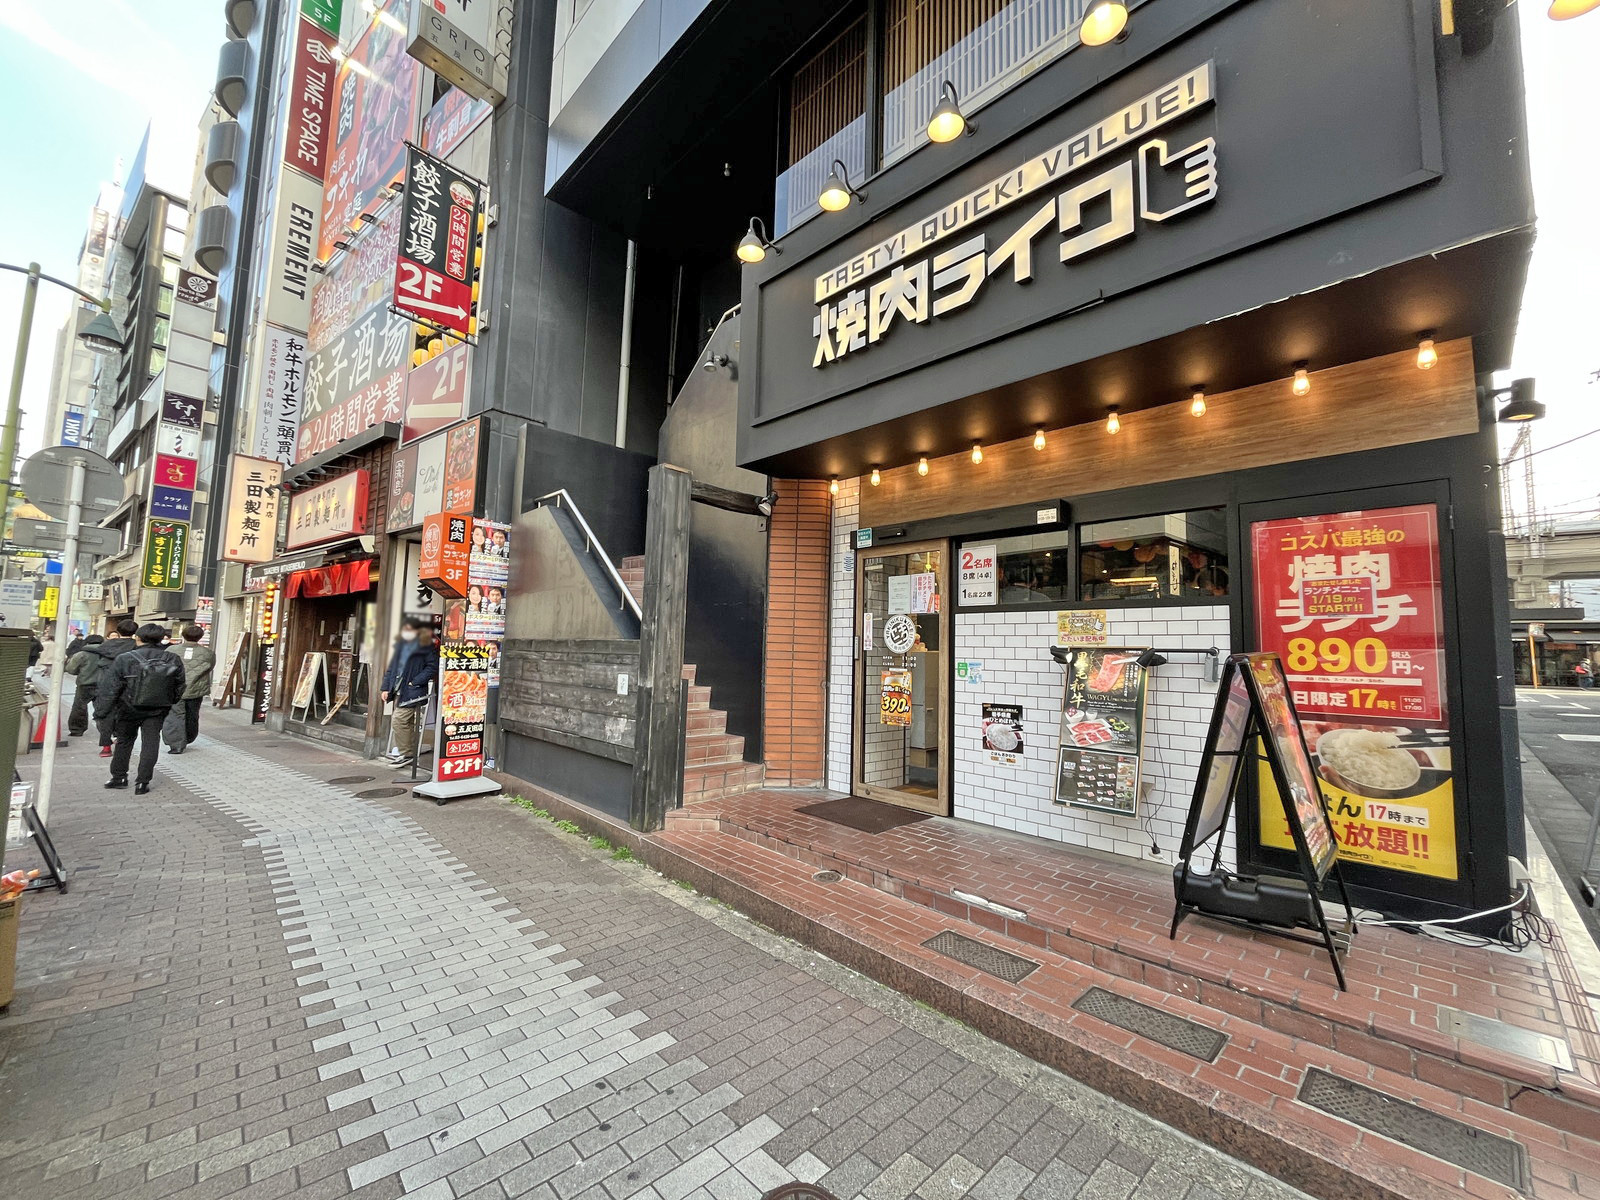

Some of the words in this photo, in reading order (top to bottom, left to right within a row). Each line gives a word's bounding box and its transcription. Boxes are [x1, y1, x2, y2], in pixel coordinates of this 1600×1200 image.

[431, 16, 485, 62] GRIO
[302, 67, 327, 111] TIME
[297, 107, 323, 167] SPACE
[821, 232, 907, 293] TASTY!
[921, 170, 1025, 243] QUICK!
[1041, 74, 1196, 177] VALUE!
[406, 158, 441, 265] 餃子酒場
[283, 202, 313, 300] EREMENT
[449, 208, 468, 276] 24時間営業
[400, 262, 443, 299] 2F
[812, 159, 1135, 368] 焼肉ライク
[432, 346, 467, 400] 2F
[276, 338, 304, 467] 和牛ホルモン一頭買い
[312, 372, 402, 454] 24時間営業
[64, 419, 80, 443] AOKI
[239, 471, 265, 548] 三田製麺所
[450, 520, 465, 542] 焼肉
[1281, 528, 1406, 551] コスパ最強の
[445, 568, 463, 580] 3F
[962, 552, 993, 569] 2名席
[1304, 586, 1370, 595] ランチメニュー
[446, 658, 488, 670] 餃子酒場
[1391, 651, 1411, 659] 税込
[1070, 651, 1088, 709] 黒毛和牛
[1087, 694, 1113, 702] WAGYU
[449, 692, 463, 708] 酒
[448, 742, 478, 754] 全125席
[453, 758, 473, 774] 2F
[1367, 804, 1427, 826] 17時まで
